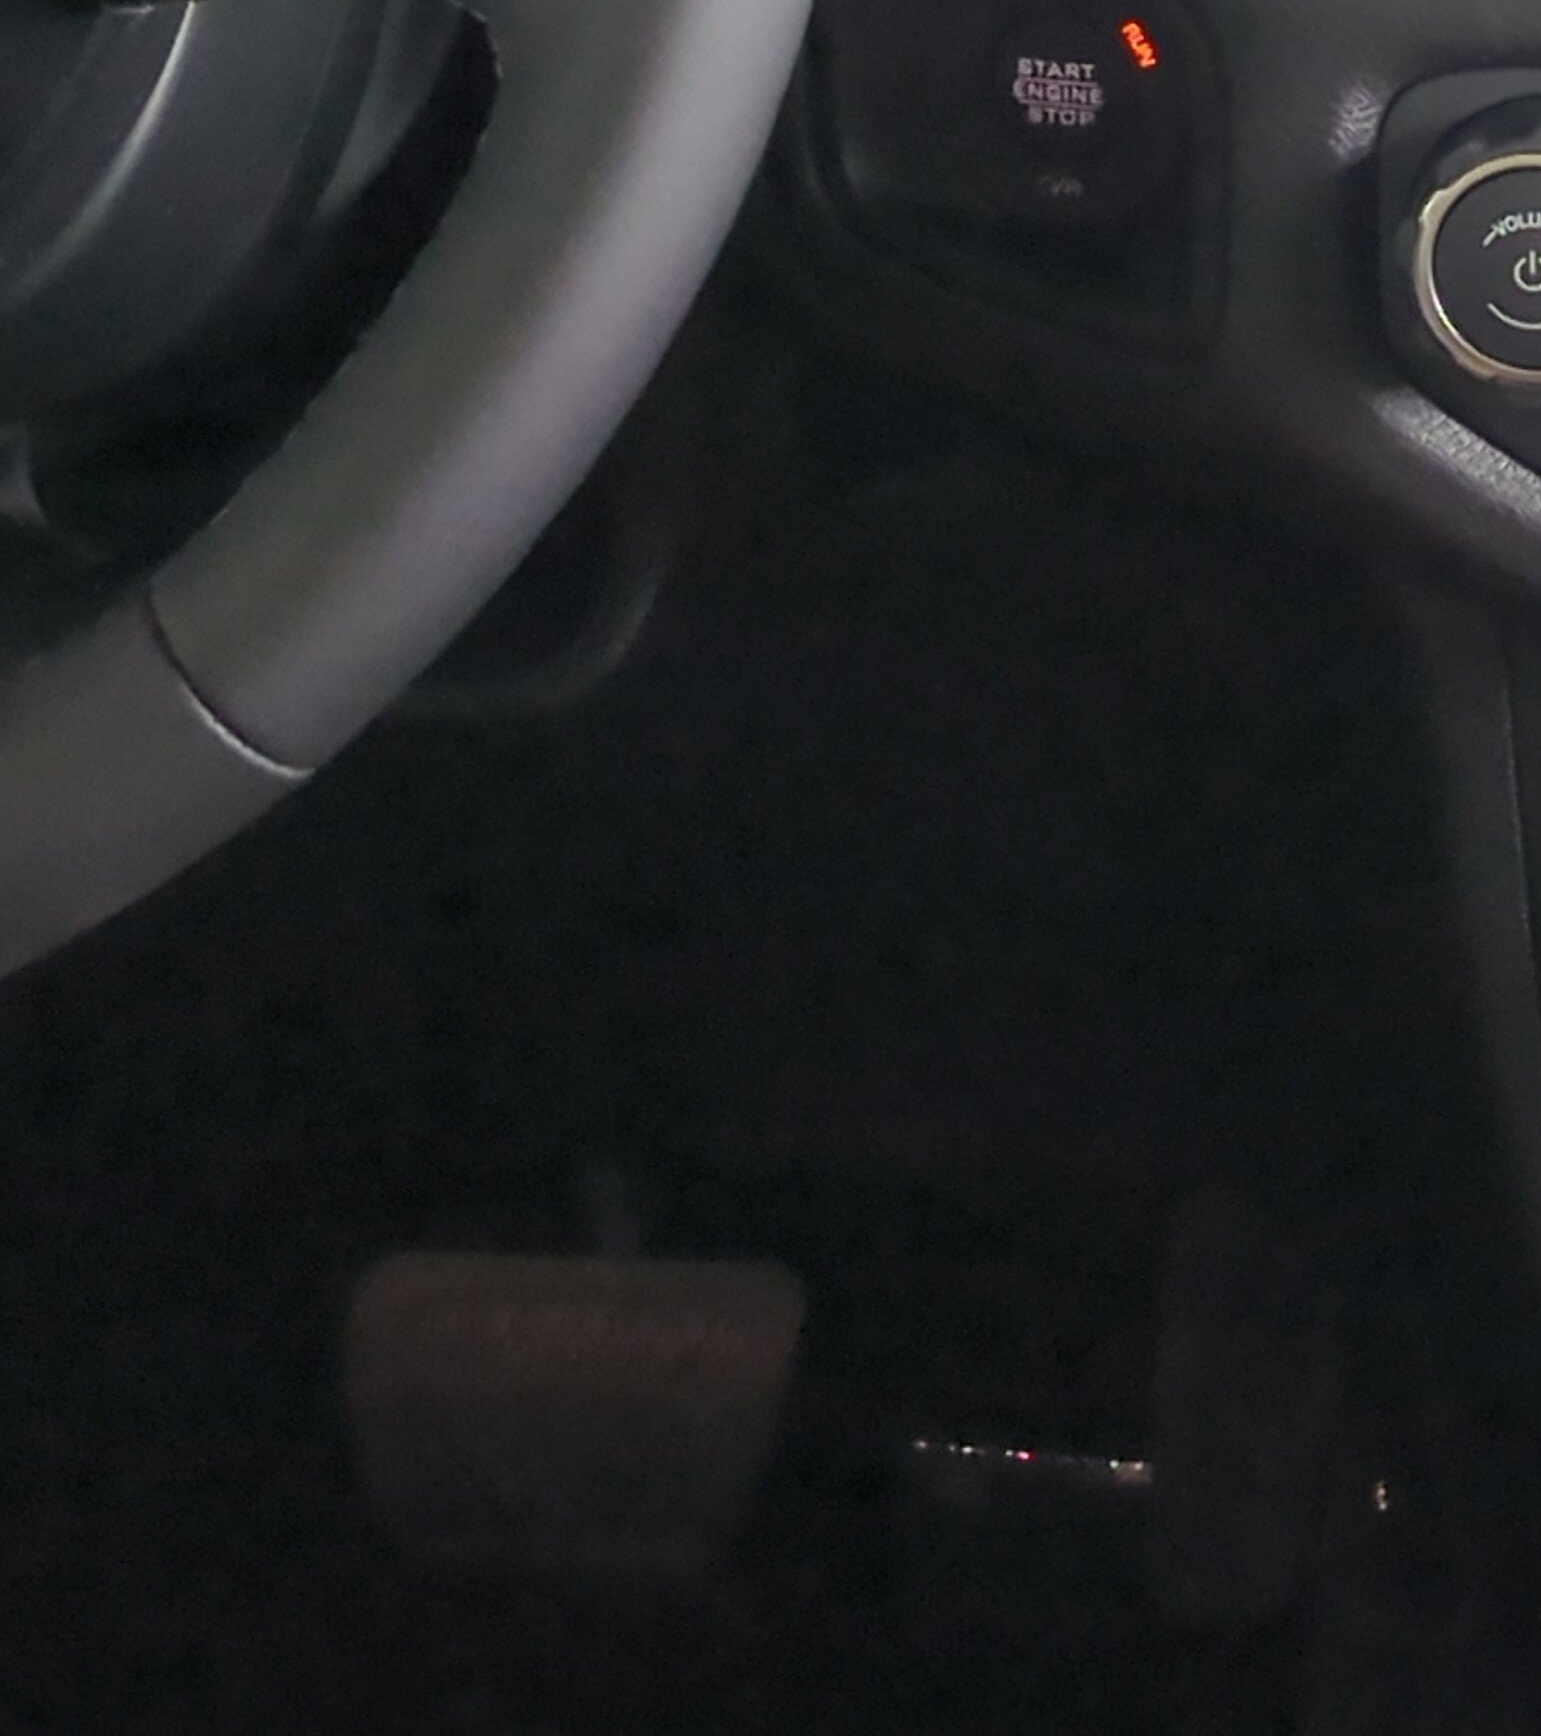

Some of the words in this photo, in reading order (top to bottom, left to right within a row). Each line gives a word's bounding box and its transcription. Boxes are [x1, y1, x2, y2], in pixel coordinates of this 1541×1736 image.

[1018, 58, 1094, 80] START
[1012, 78, 1103, 105] ENGINE
[1028, 106, 1096, 126] STOP
